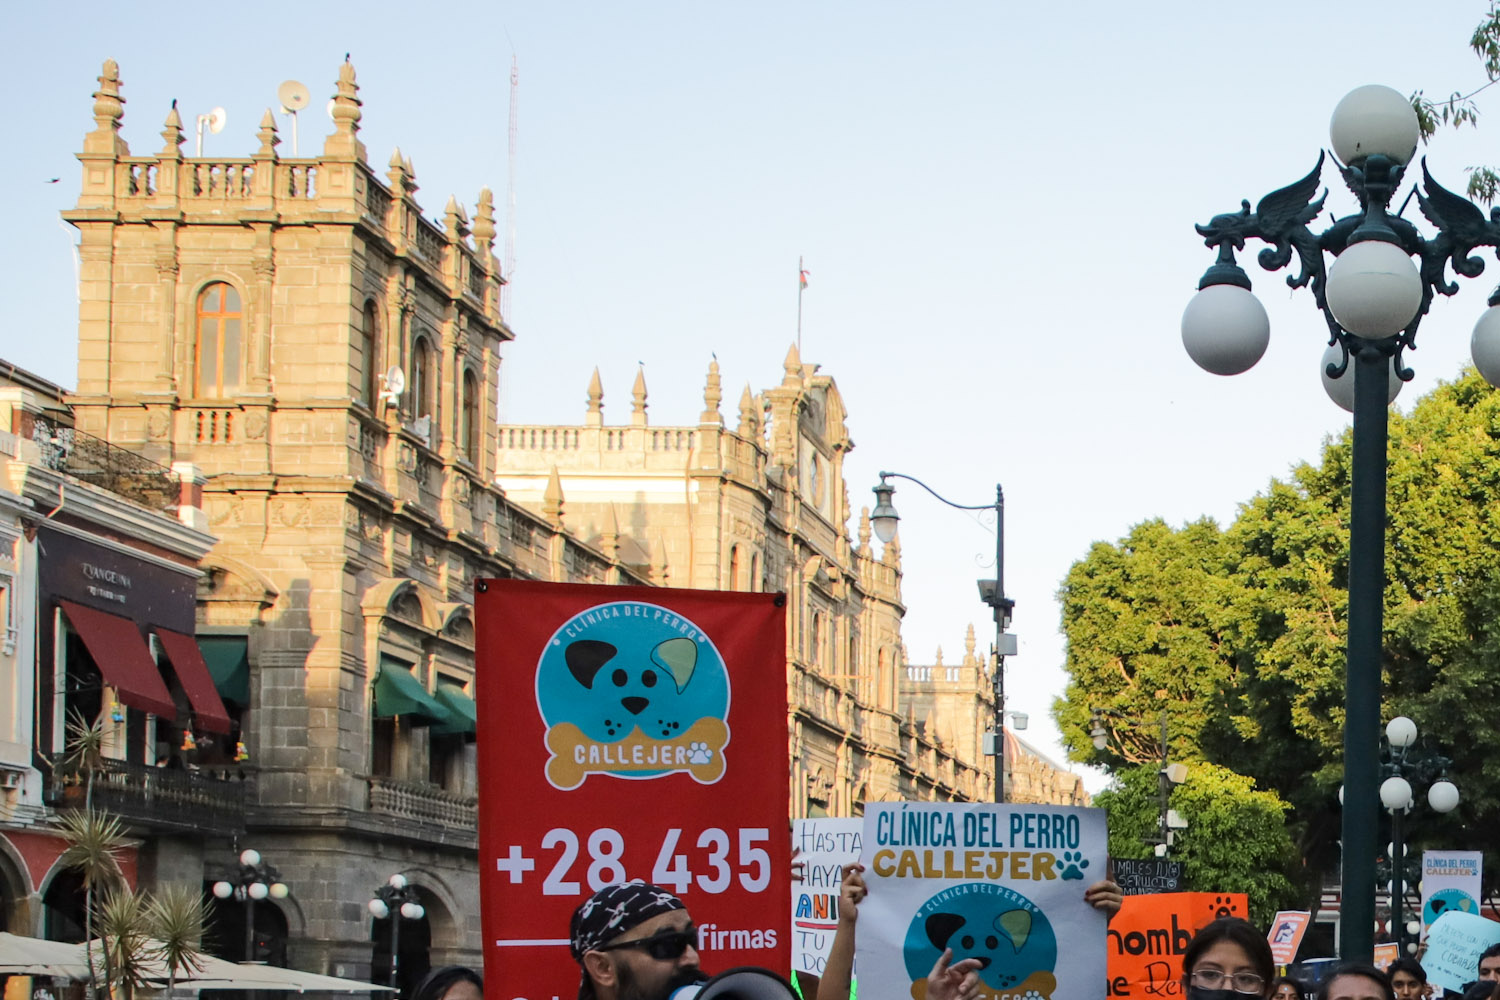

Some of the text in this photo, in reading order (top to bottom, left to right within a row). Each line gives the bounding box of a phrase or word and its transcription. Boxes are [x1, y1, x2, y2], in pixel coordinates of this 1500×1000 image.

[624, 605, 649, 618] DEL
[654, 610, 697, 639] PERRO
[800, 822, 862, 853] HASTA
[876, 804, 1080, 849] CLÍNICA DEL PERRO
[795, 893, 841, 920] ANI
[973, 884, 993, 894] DEL
[997, 888, 1031, 910] PERRO
[698, 925, 777, 950] firmas
[796, 930, 825, 951] TU
[1107, 914, 1201, 955] omb
